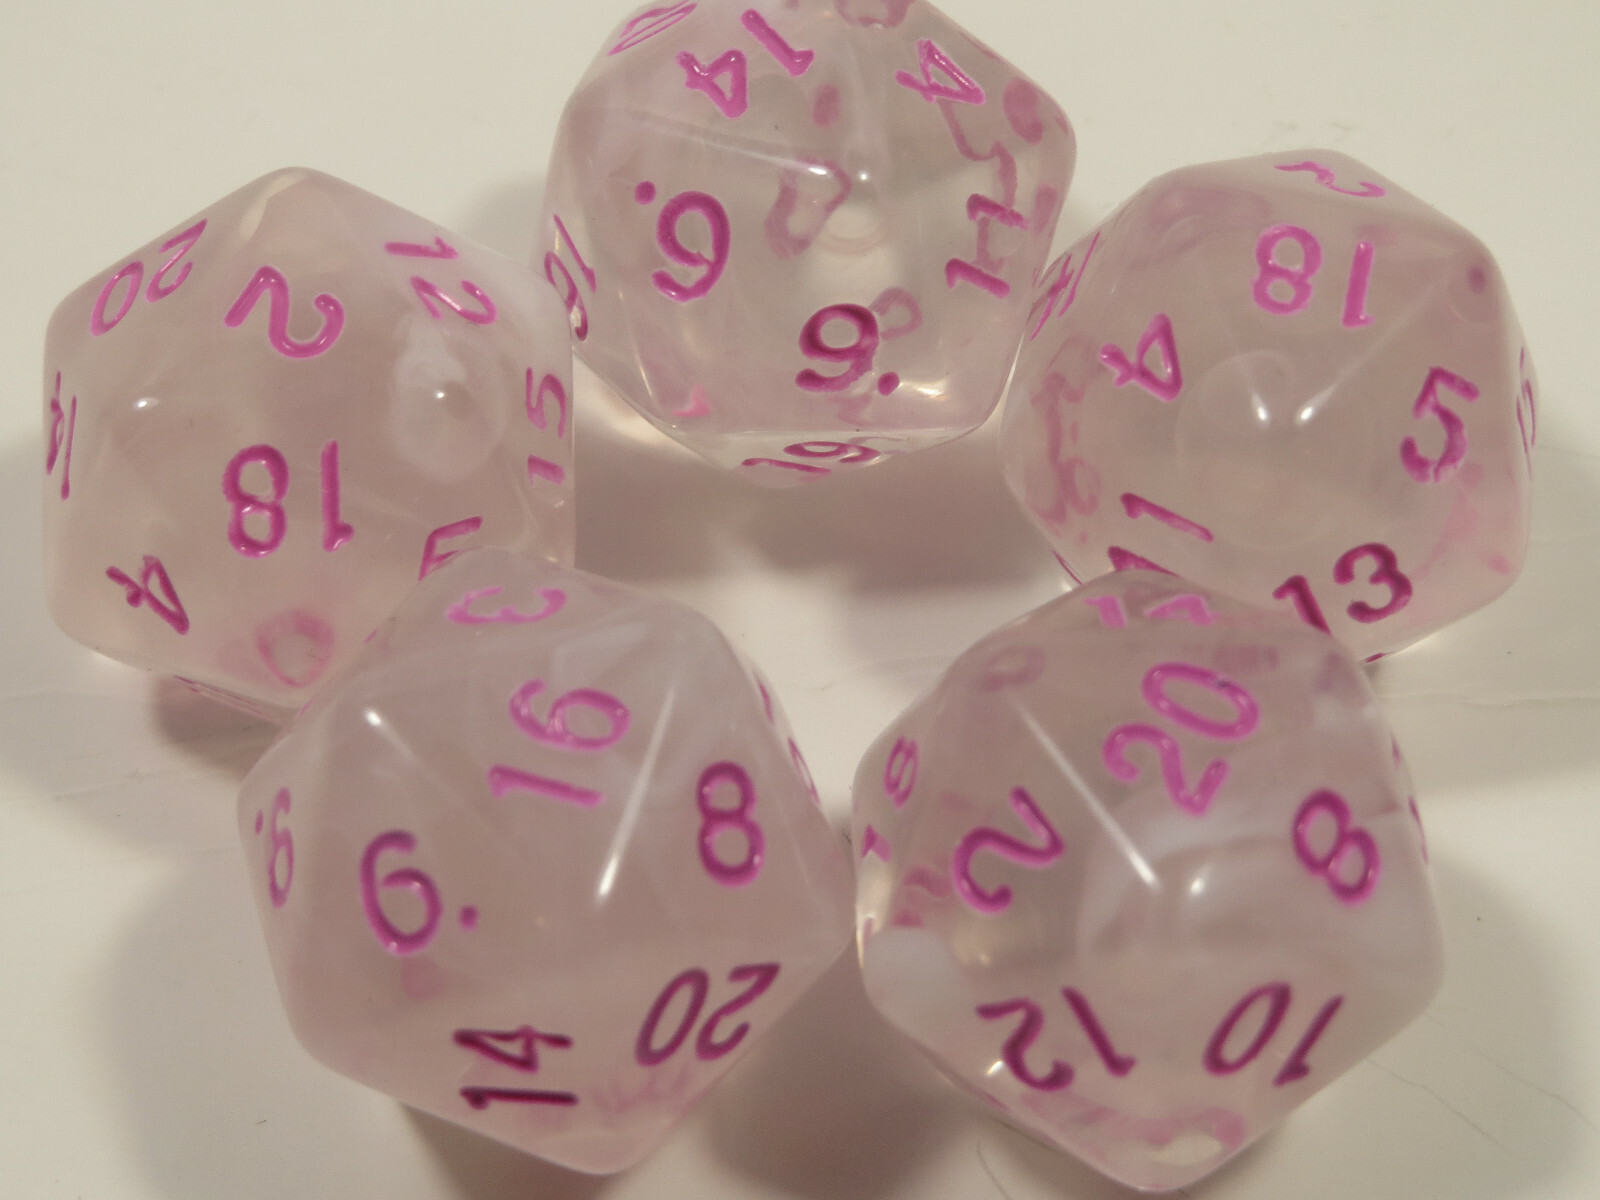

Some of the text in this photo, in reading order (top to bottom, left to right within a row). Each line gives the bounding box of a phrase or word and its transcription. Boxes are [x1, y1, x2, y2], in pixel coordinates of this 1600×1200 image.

[675, 8, 814, 119] 14
[895, 39, 986, 106] 4
[91, 218, 208, 337] 20
[224, 265, 346, 359] 2
[384, 236, 497, 325] 12
[1251, 224, 1376, 328] 18
[1099, 312, 1183, 401] 4
[1400, 366, 1481, 483] 5
[222, 440, 355, 559] 18
[105, 555, 190, 635] 4
[1272, 542, 1413, 637] 13
[488, 678, 632, 806] 16
[1101, 662, 1260, 816] 20
[695, 759, 766, 888] 8
[951, 785, 1065, 915] 2
[1291, 787, 1381, 906] 8
[452, 1024, 579, 1110] 14
[634, 961, 782, 1067] 20
[976, 984, 1137, 1091] 12
[1203, 981, 1346, 1088] 10
